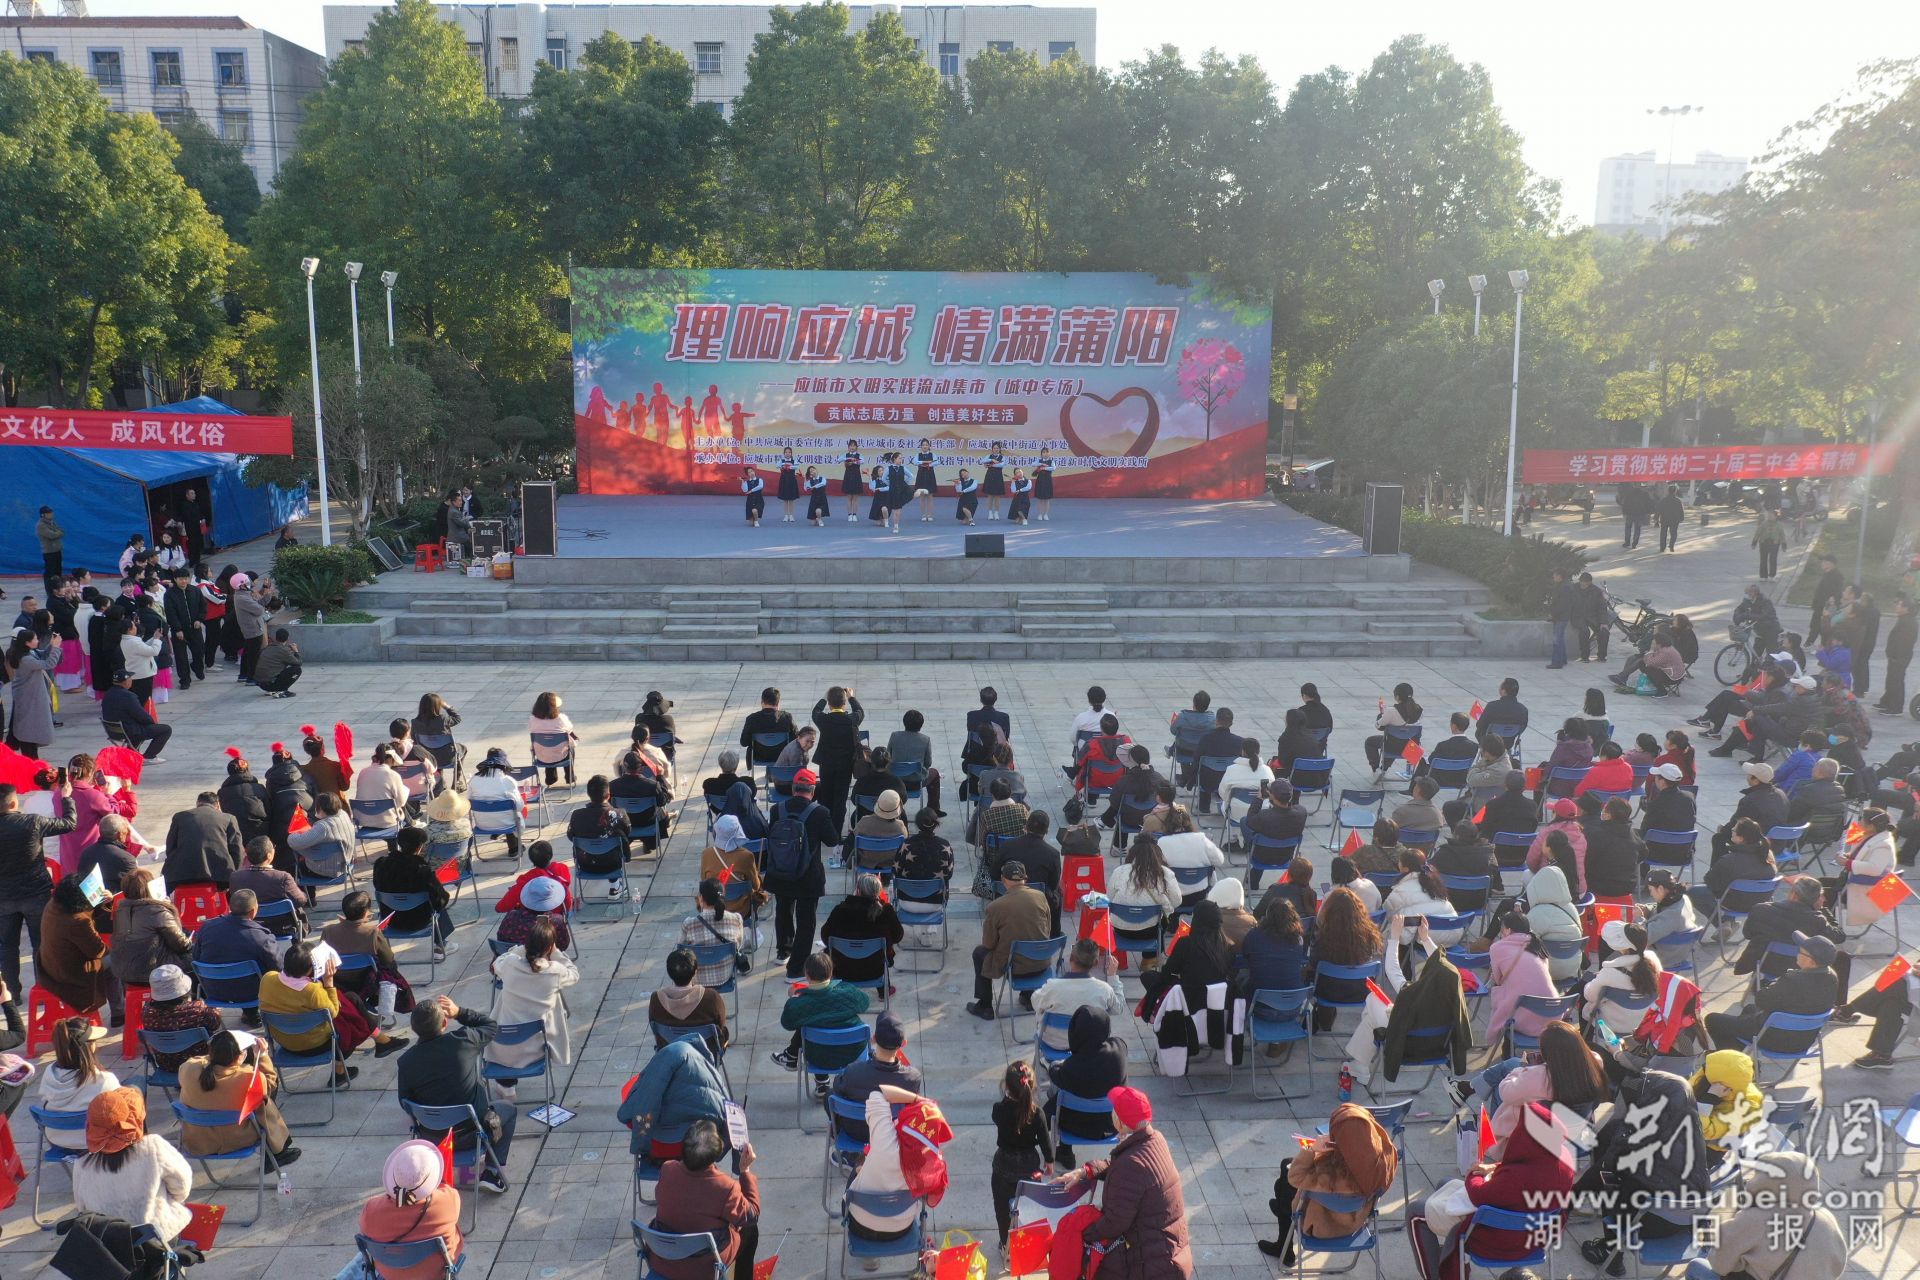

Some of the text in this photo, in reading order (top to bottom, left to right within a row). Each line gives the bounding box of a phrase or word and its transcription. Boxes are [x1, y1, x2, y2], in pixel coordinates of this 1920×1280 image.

[667, 303, 1179, 367] 理响应城 情满蒲阳
[828, 407, 1015, 423] 贡献志愿力量 创造美好生活
[1, 415, 225, 446] 文化人 成风化俗
[1569, 451, 1856, 476] 学习贯彻党的二十届三中全会精神
